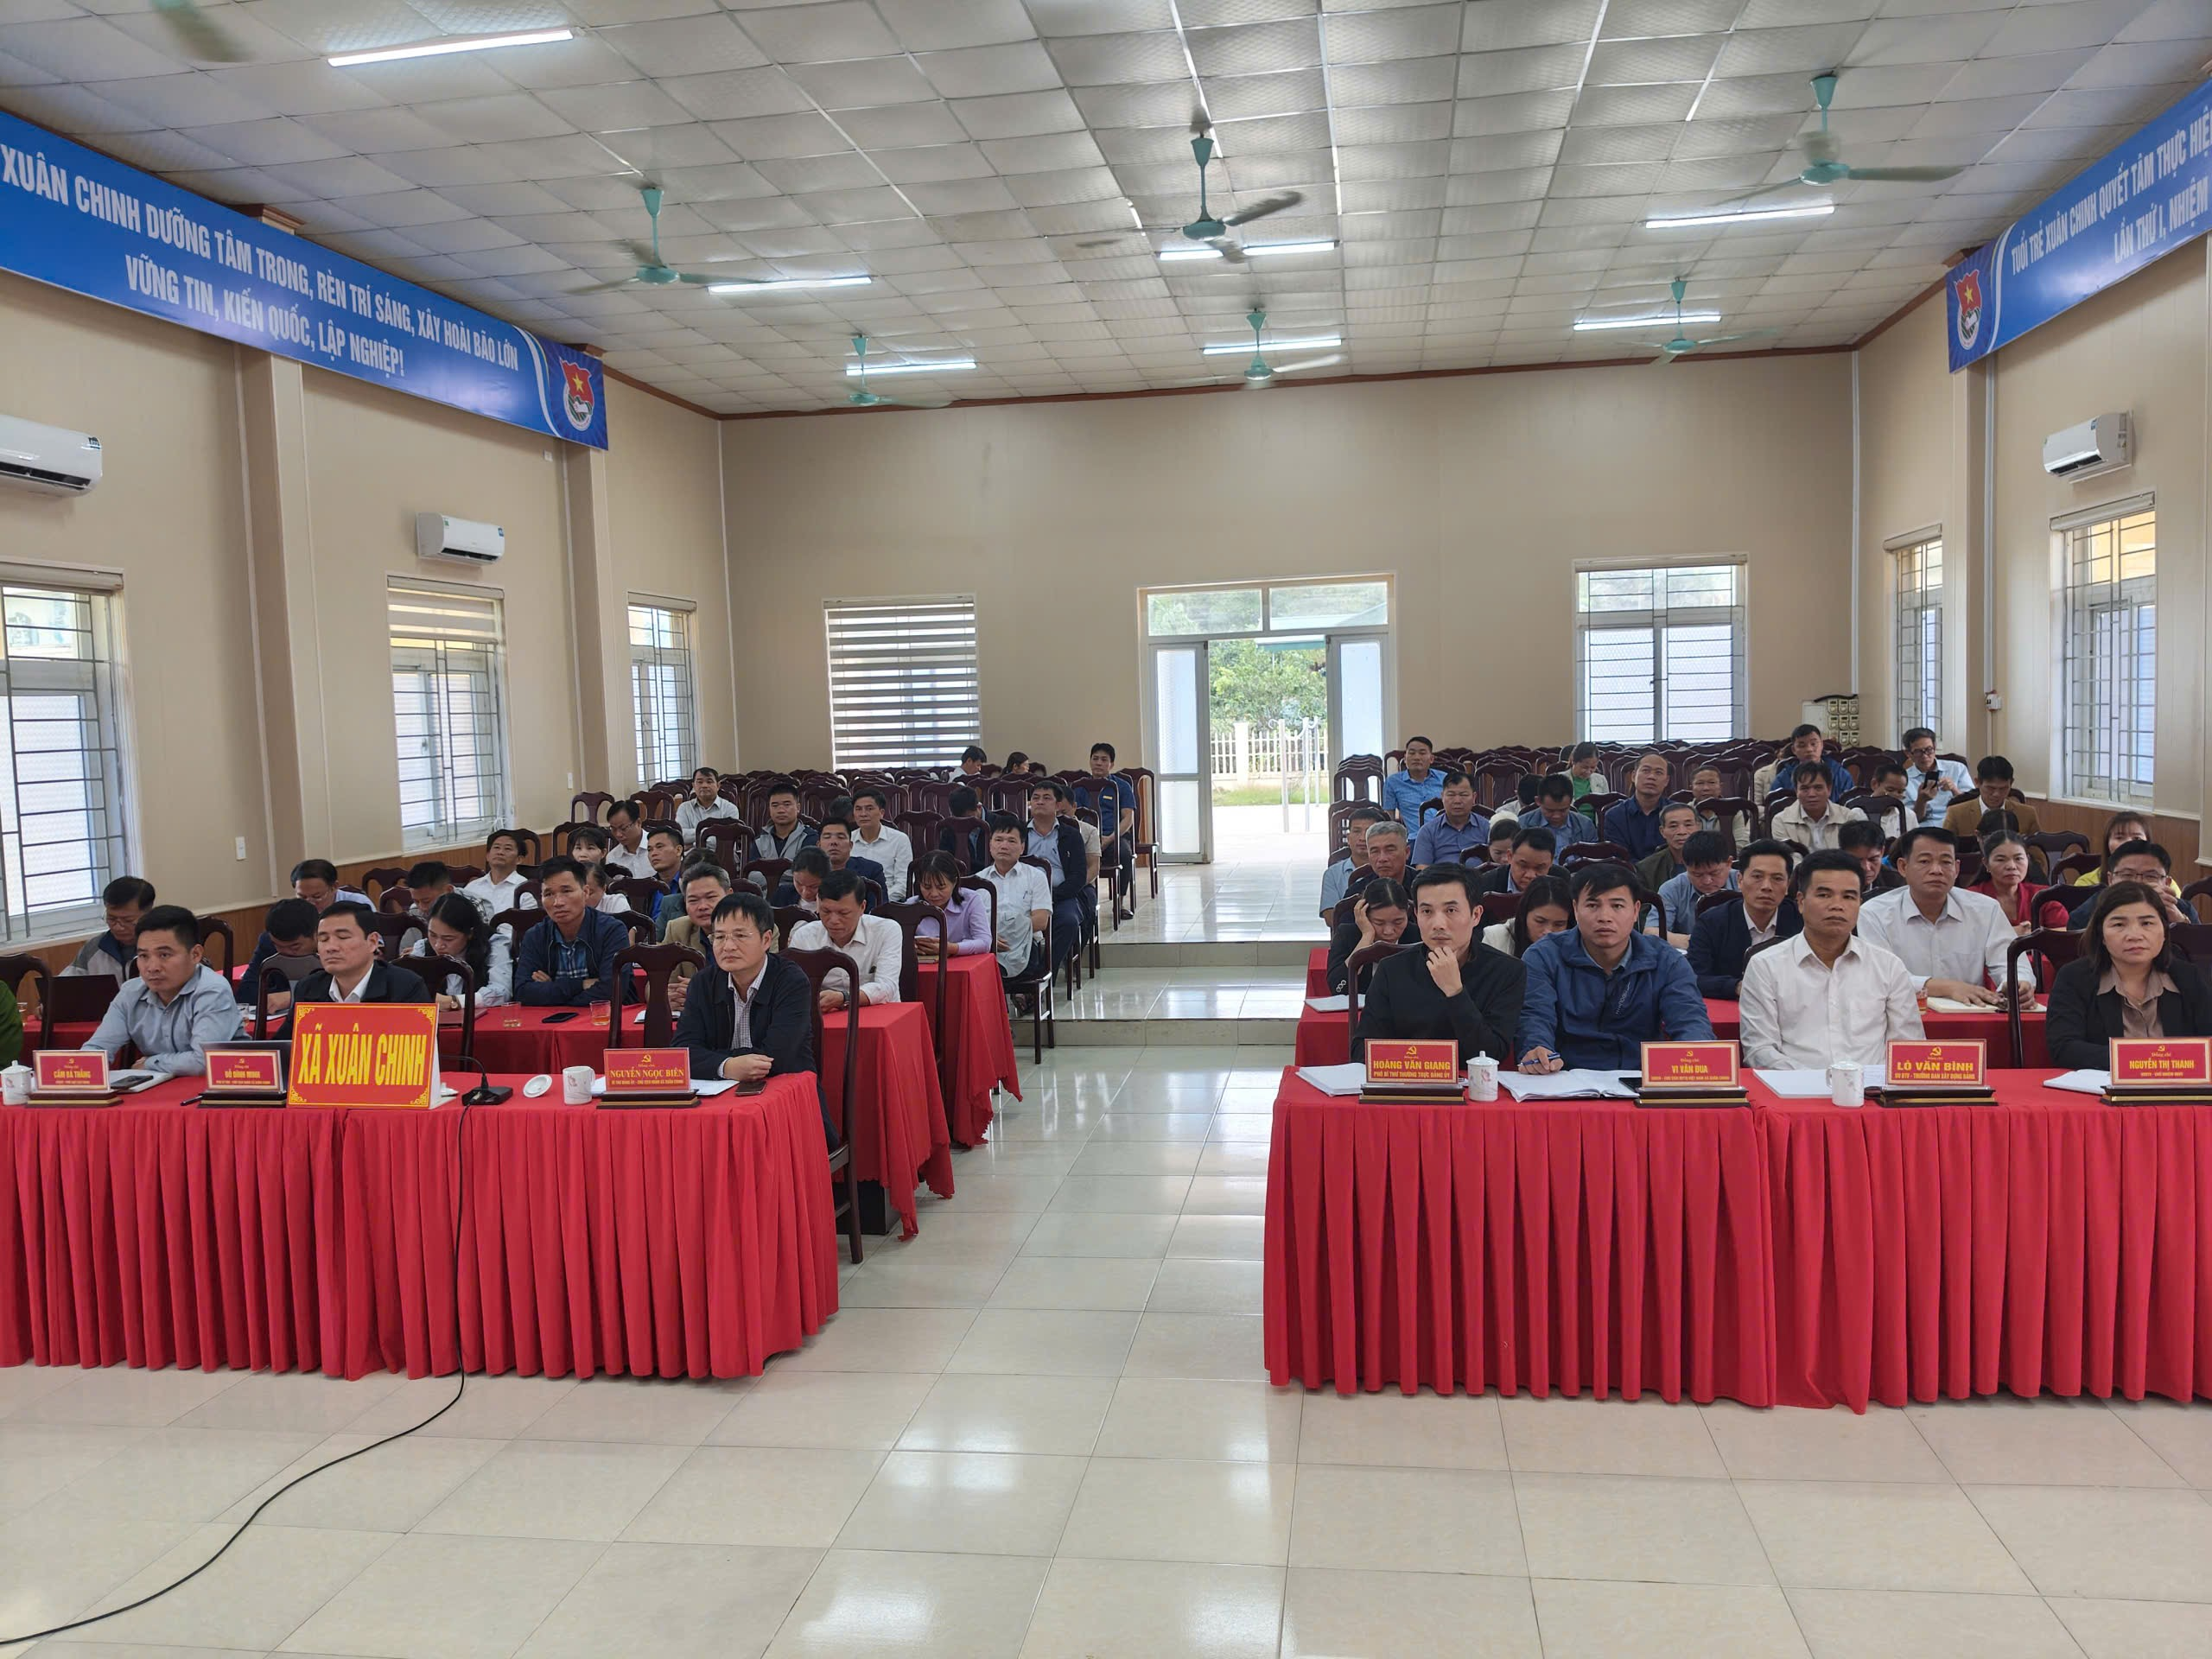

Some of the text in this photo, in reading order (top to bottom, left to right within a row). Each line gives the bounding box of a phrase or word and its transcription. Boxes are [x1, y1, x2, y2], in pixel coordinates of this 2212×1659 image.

[2011, 105, 2212, 276] TUỔI TRẺ XUÂN CHINH QUYẾT TÂM THỰC HIỆ
[2114, 216, 2134, 264] LẦN
[2135, 202, 2158, 251] THỨ
[2169, 176, 2209, 232] NHIỆM
[1, 143, 518, 372] XUÂN CHINH DƯỠNG TÂM TRONG, RÈN TRÍ SÁNG, XÂY HOÀI BÃO LỚN
[125, 253, 405, 378] VỮNG TIN, KIẾN QUỐC, LẬP NGHIỆP!
[297, 1022, 428, 1086] XÃ XUÂN CHINH
[642, 1069, 664, 1079] NGỌC
[1373, 1058, 1451, 1071] HOÀNG VĂN GIANG
[1916, 1060, 1941, 1071] VĂN
[2171, 1059, 2195, 1069] THANH
